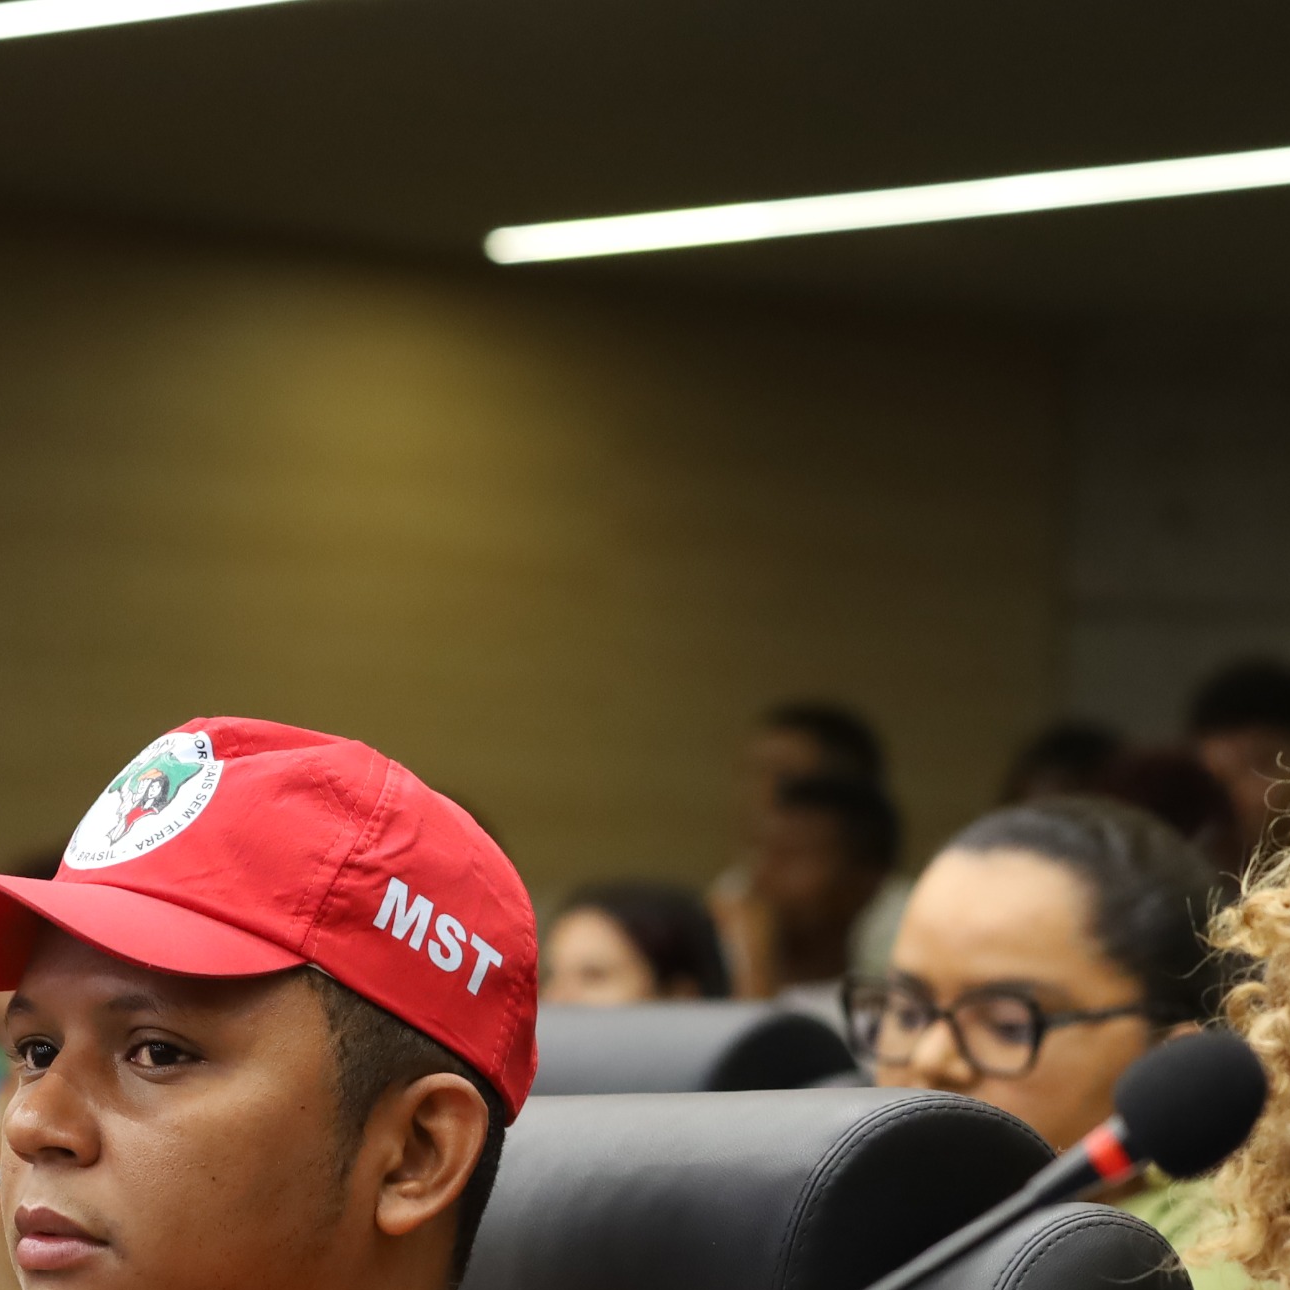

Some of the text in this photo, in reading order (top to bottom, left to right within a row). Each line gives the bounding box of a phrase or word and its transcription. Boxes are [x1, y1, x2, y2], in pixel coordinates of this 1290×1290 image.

[182, 793, 207, 819] SEM
[135, 820, 183, 851] TERRA
[77, 850, 116, 862] BRASIL
[372, 876, 503, 996] MST
